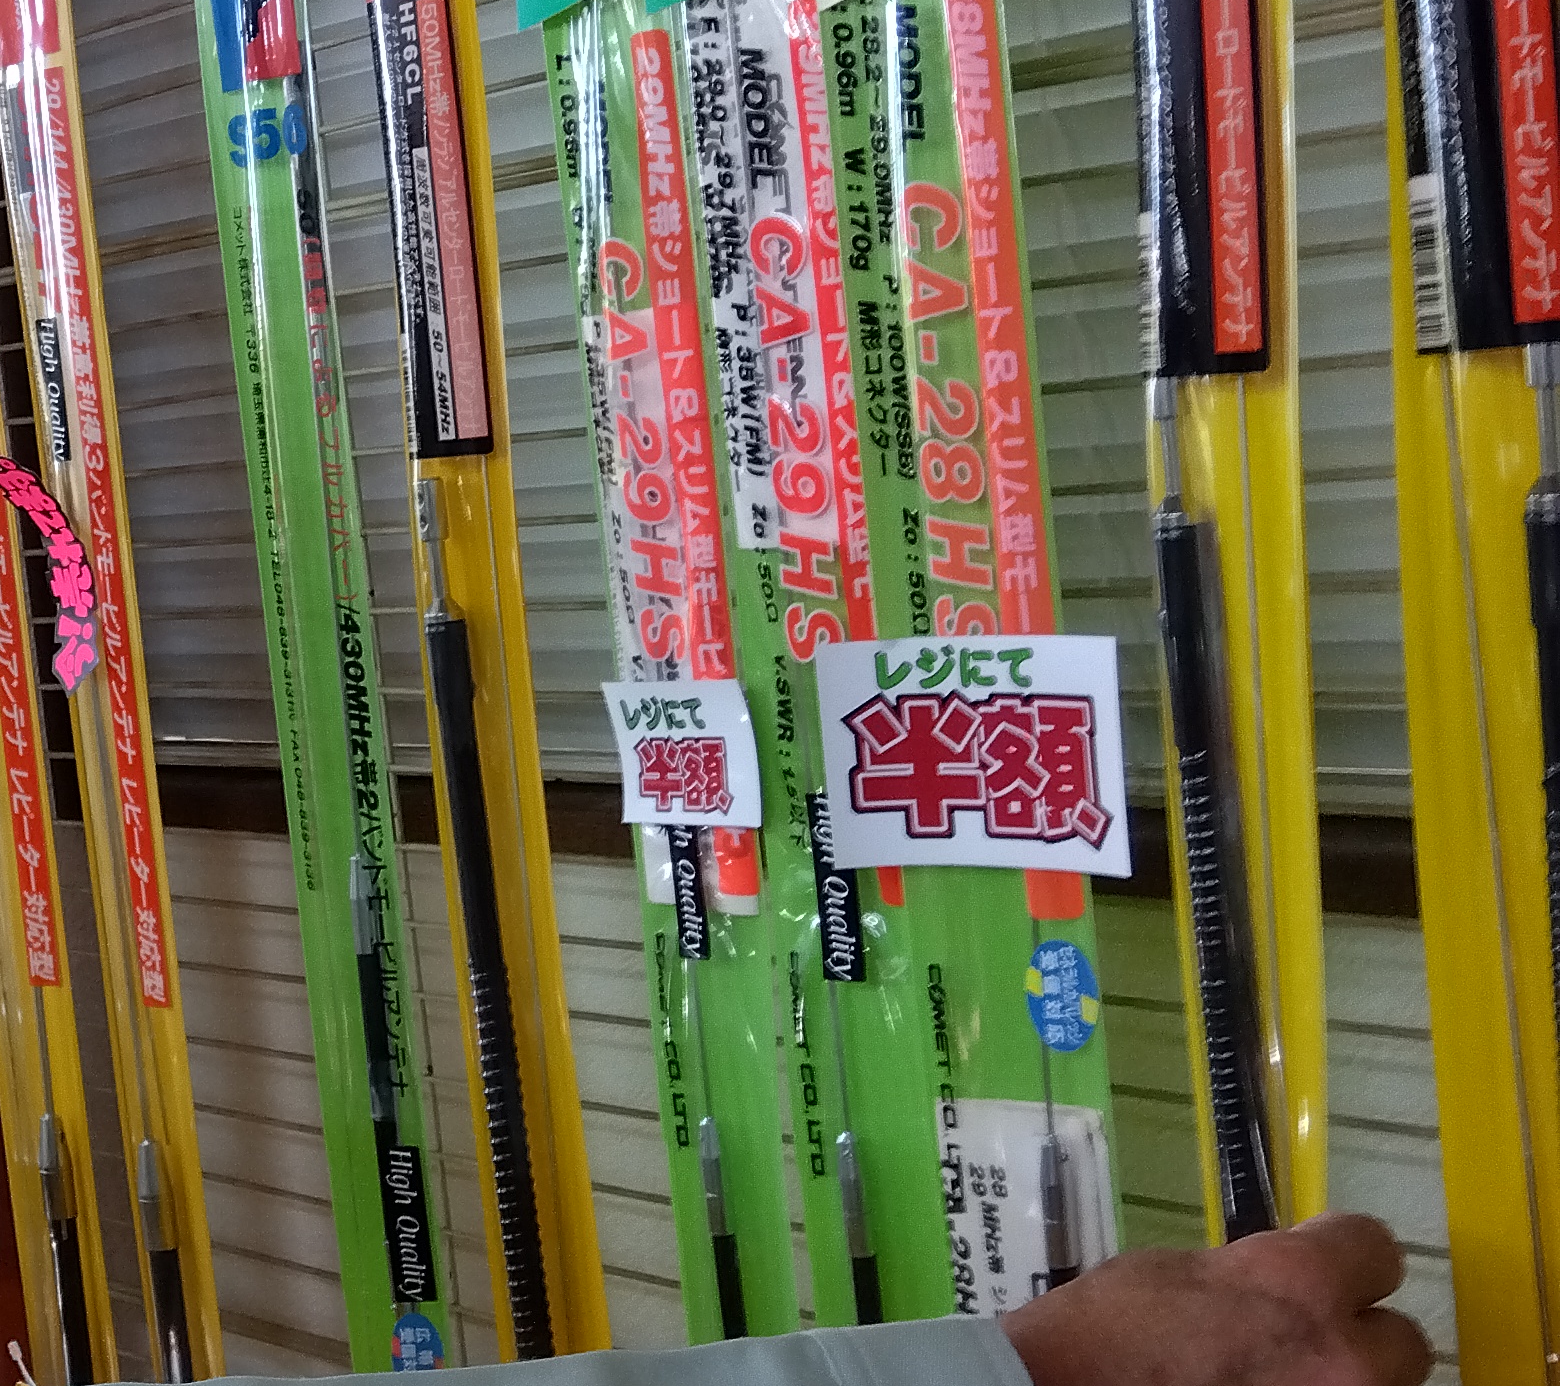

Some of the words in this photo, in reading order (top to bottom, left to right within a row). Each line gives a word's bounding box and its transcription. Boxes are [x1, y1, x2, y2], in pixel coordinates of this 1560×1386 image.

[397, 0, 422, 106] HF6CL
[895, 3, 927, 153] MODEL
[739, 48, 774, 190] MODEL
[39, 320, 59, 373] High
[45, 381, 67, 462] Quality
[597, 236, 687, 663] CA-29HS
[748, 215, 846, 663] CA-29HS
[901, 181, 998, 638] CA-28HS
[619, 697, 707, 732] レジにて
[874, 647, 1034, 690] レジにて
[632, 736, 732, 816] 半額
[842, 692, 1114, 849] 半額
[9, 767, 58, 982] レピーター対応型
[121, 776, 167, 1002] レピーター対応型
[677, 858, 705, 961] Quality
[821, 874, 857, 983] Quality
[385, 1149, 418, 1204] High
[394, 1214, 428, 1301] Quality
